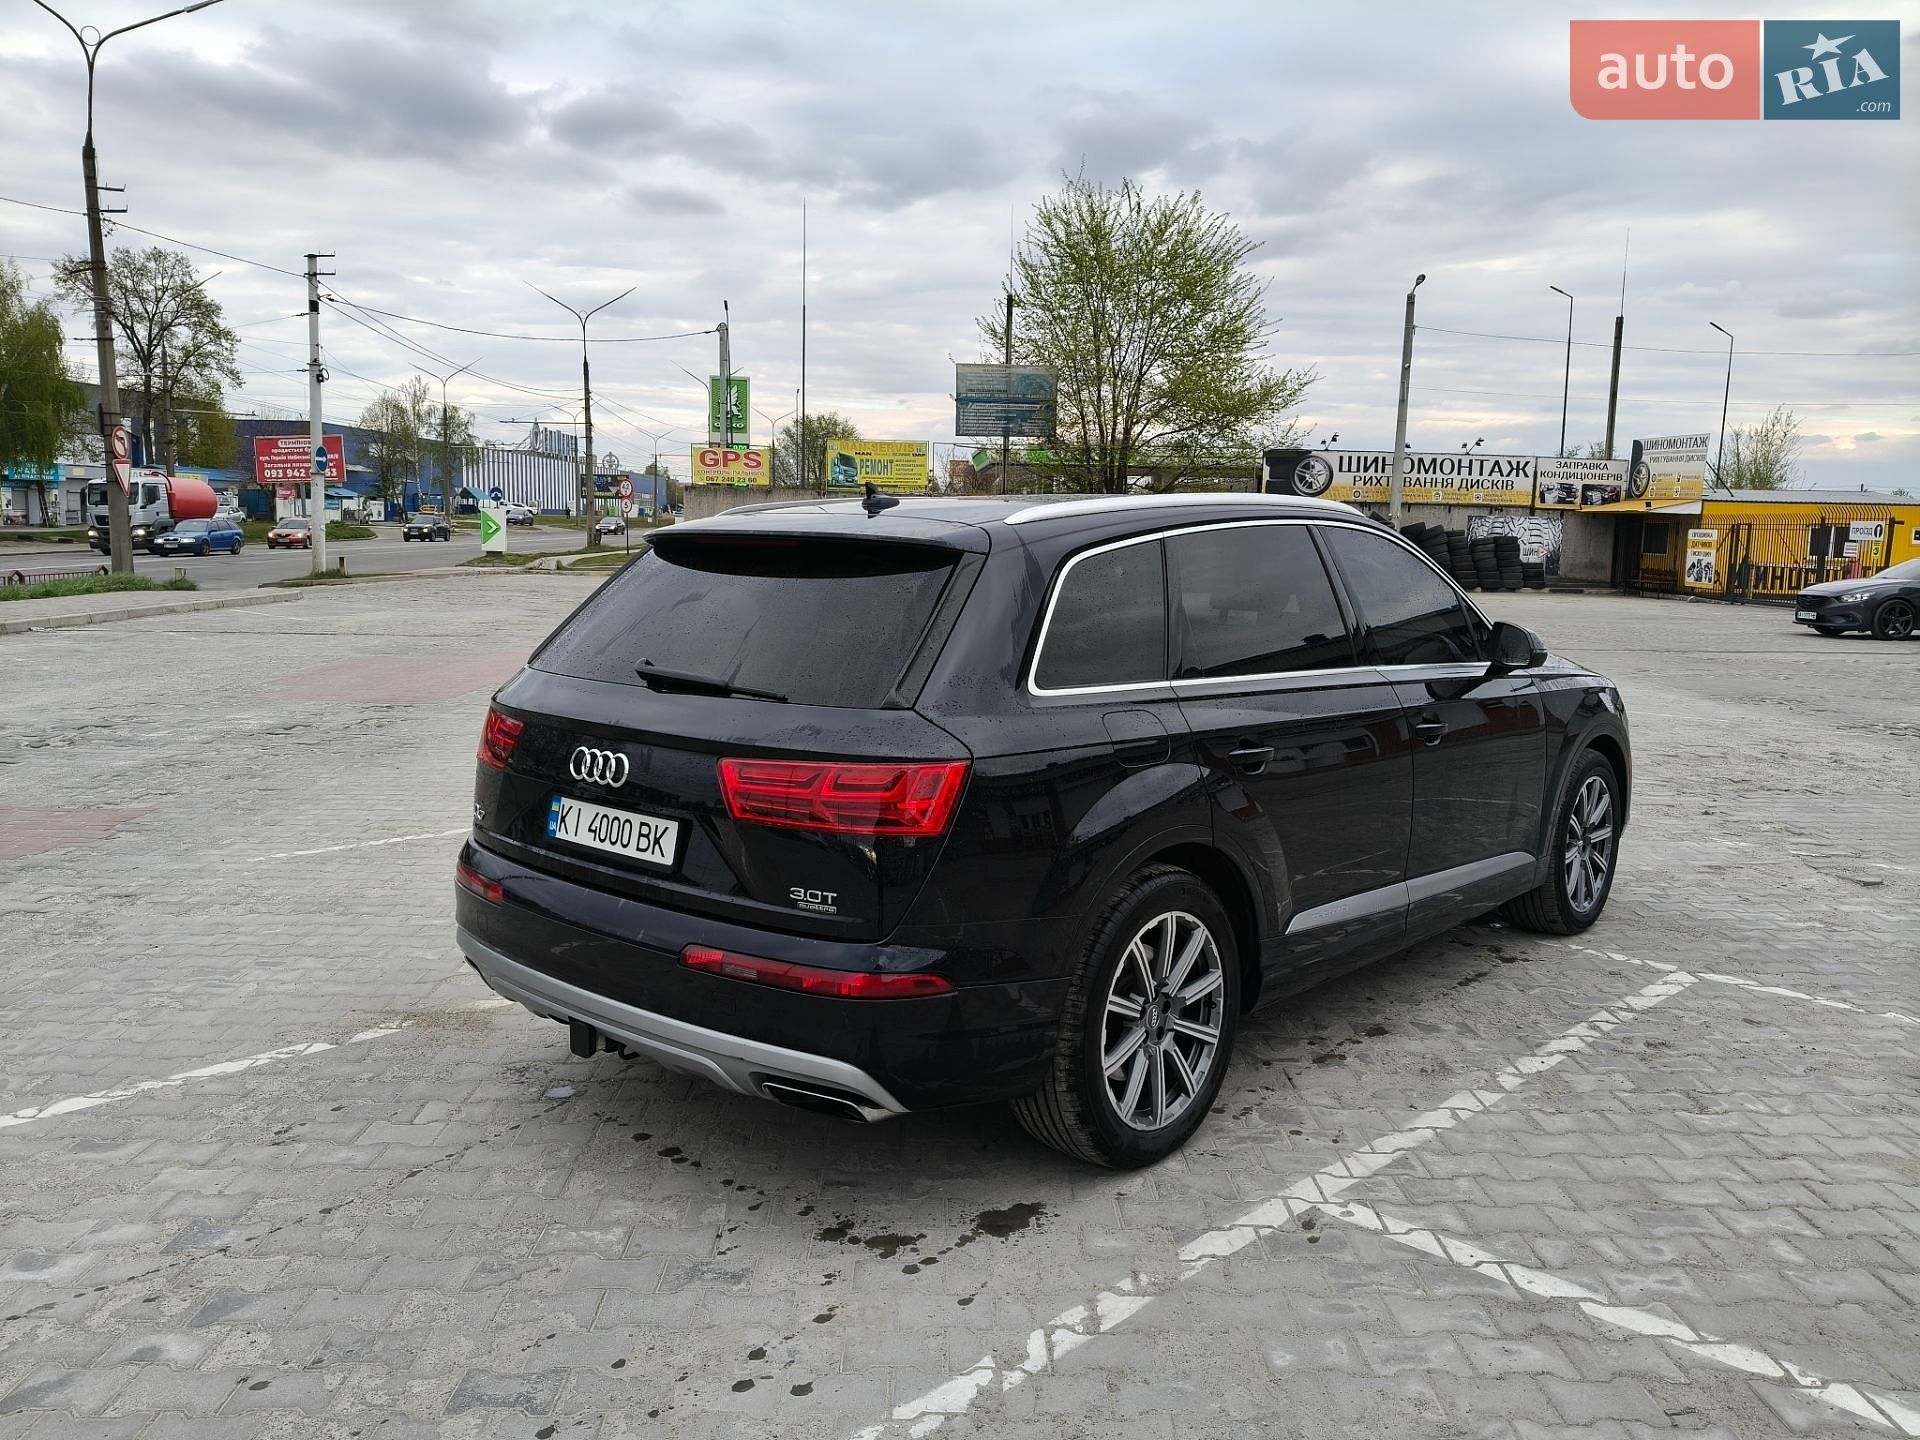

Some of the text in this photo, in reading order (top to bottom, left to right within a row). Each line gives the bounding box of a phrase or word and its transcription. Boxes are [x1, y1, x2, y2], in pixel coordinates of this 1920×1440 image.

[1644, 436, 1709, 451] ШИНОМОНТАЖ
[698, 449, 763, 469] GPS
[861, 458, 894, 477] РЕМОНТ
[1555, 460, 1609, 471] ЗАПРАВКА
[1353, 475, 1515, 492] РИХТВАННЯ ДИСКІВ
[1539, 470, 1623, 481] КОНДИЦІОНЕРІВ
[1851, 526, 1873, 536] ПРОЇЗД
[587, 812, 633, 849] 4000
[636, 821, 670, 858] BK
[789, 887, 838, 905] 3.0T
